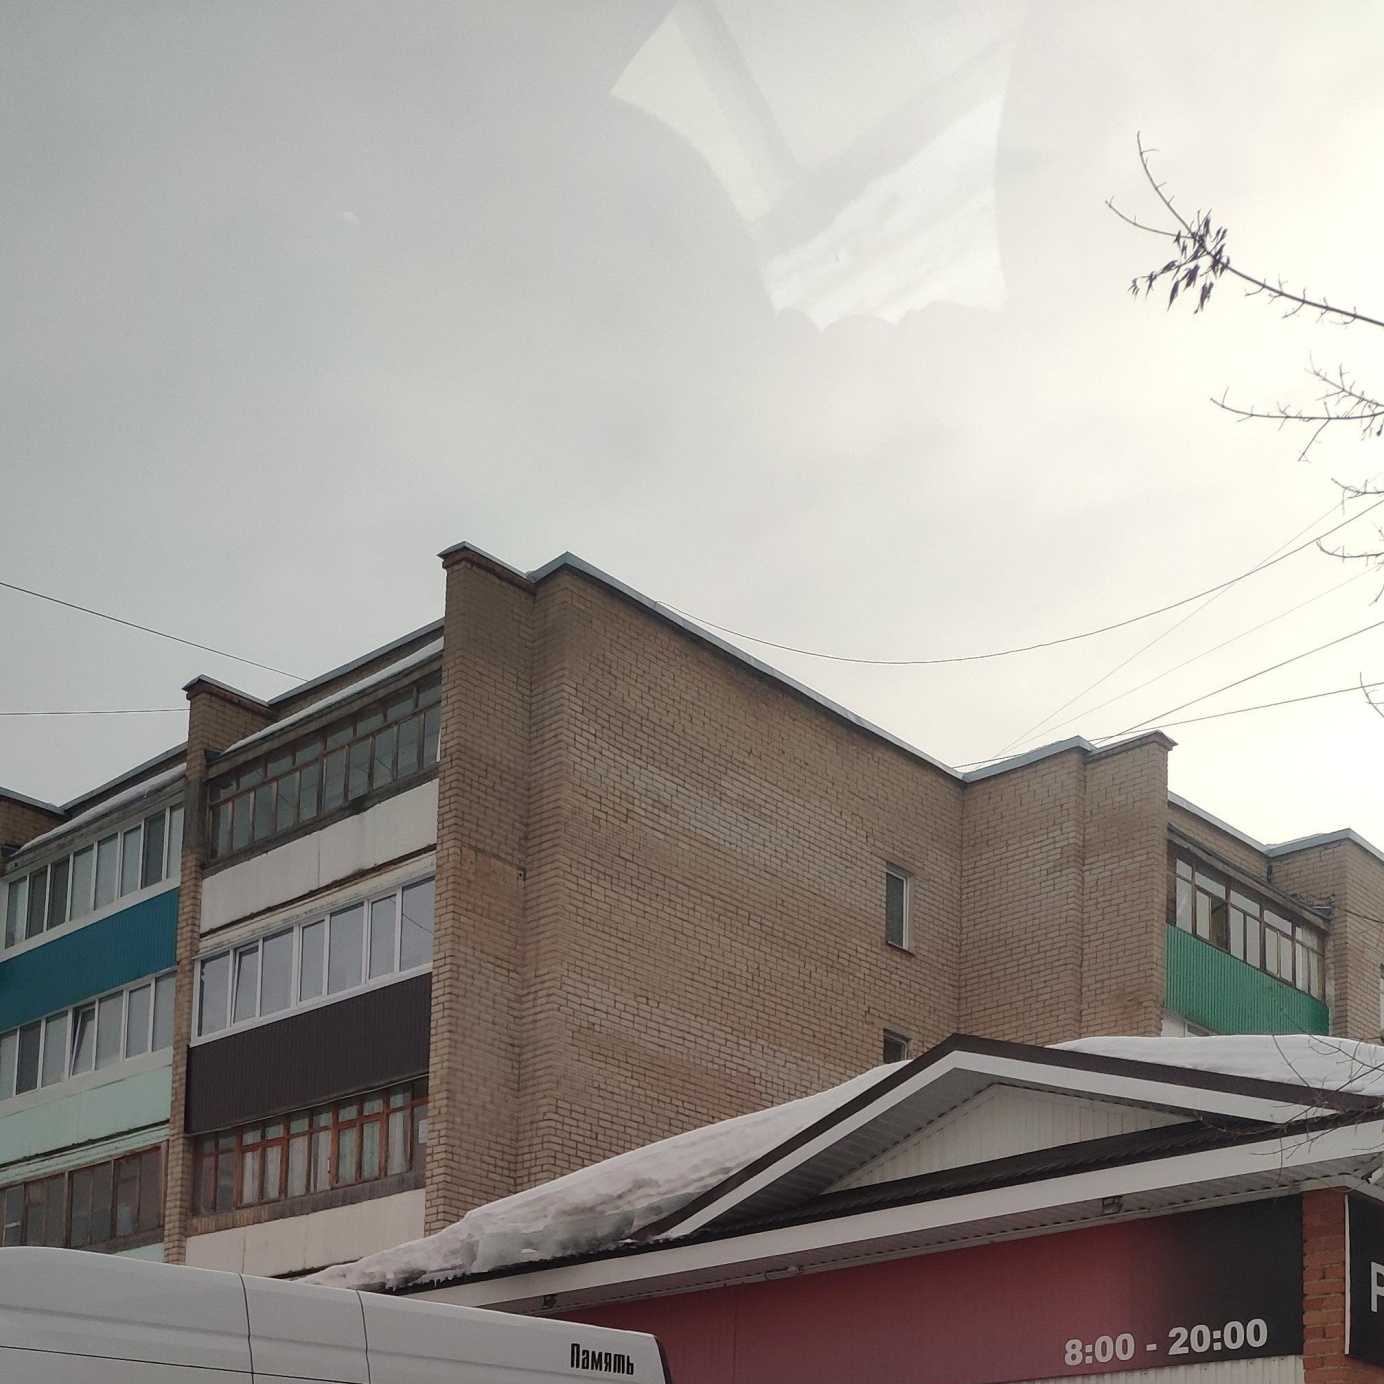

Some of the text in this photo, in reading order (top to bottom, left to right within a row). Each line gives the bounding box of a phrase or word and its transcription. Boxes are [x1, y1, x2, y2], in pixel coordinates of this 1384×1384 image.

[570, 1343, 634, 1375] Память
[1064, 1333, 1135, 1366] 8:00
[1167, 1318, 1268, 1356] 20:00
